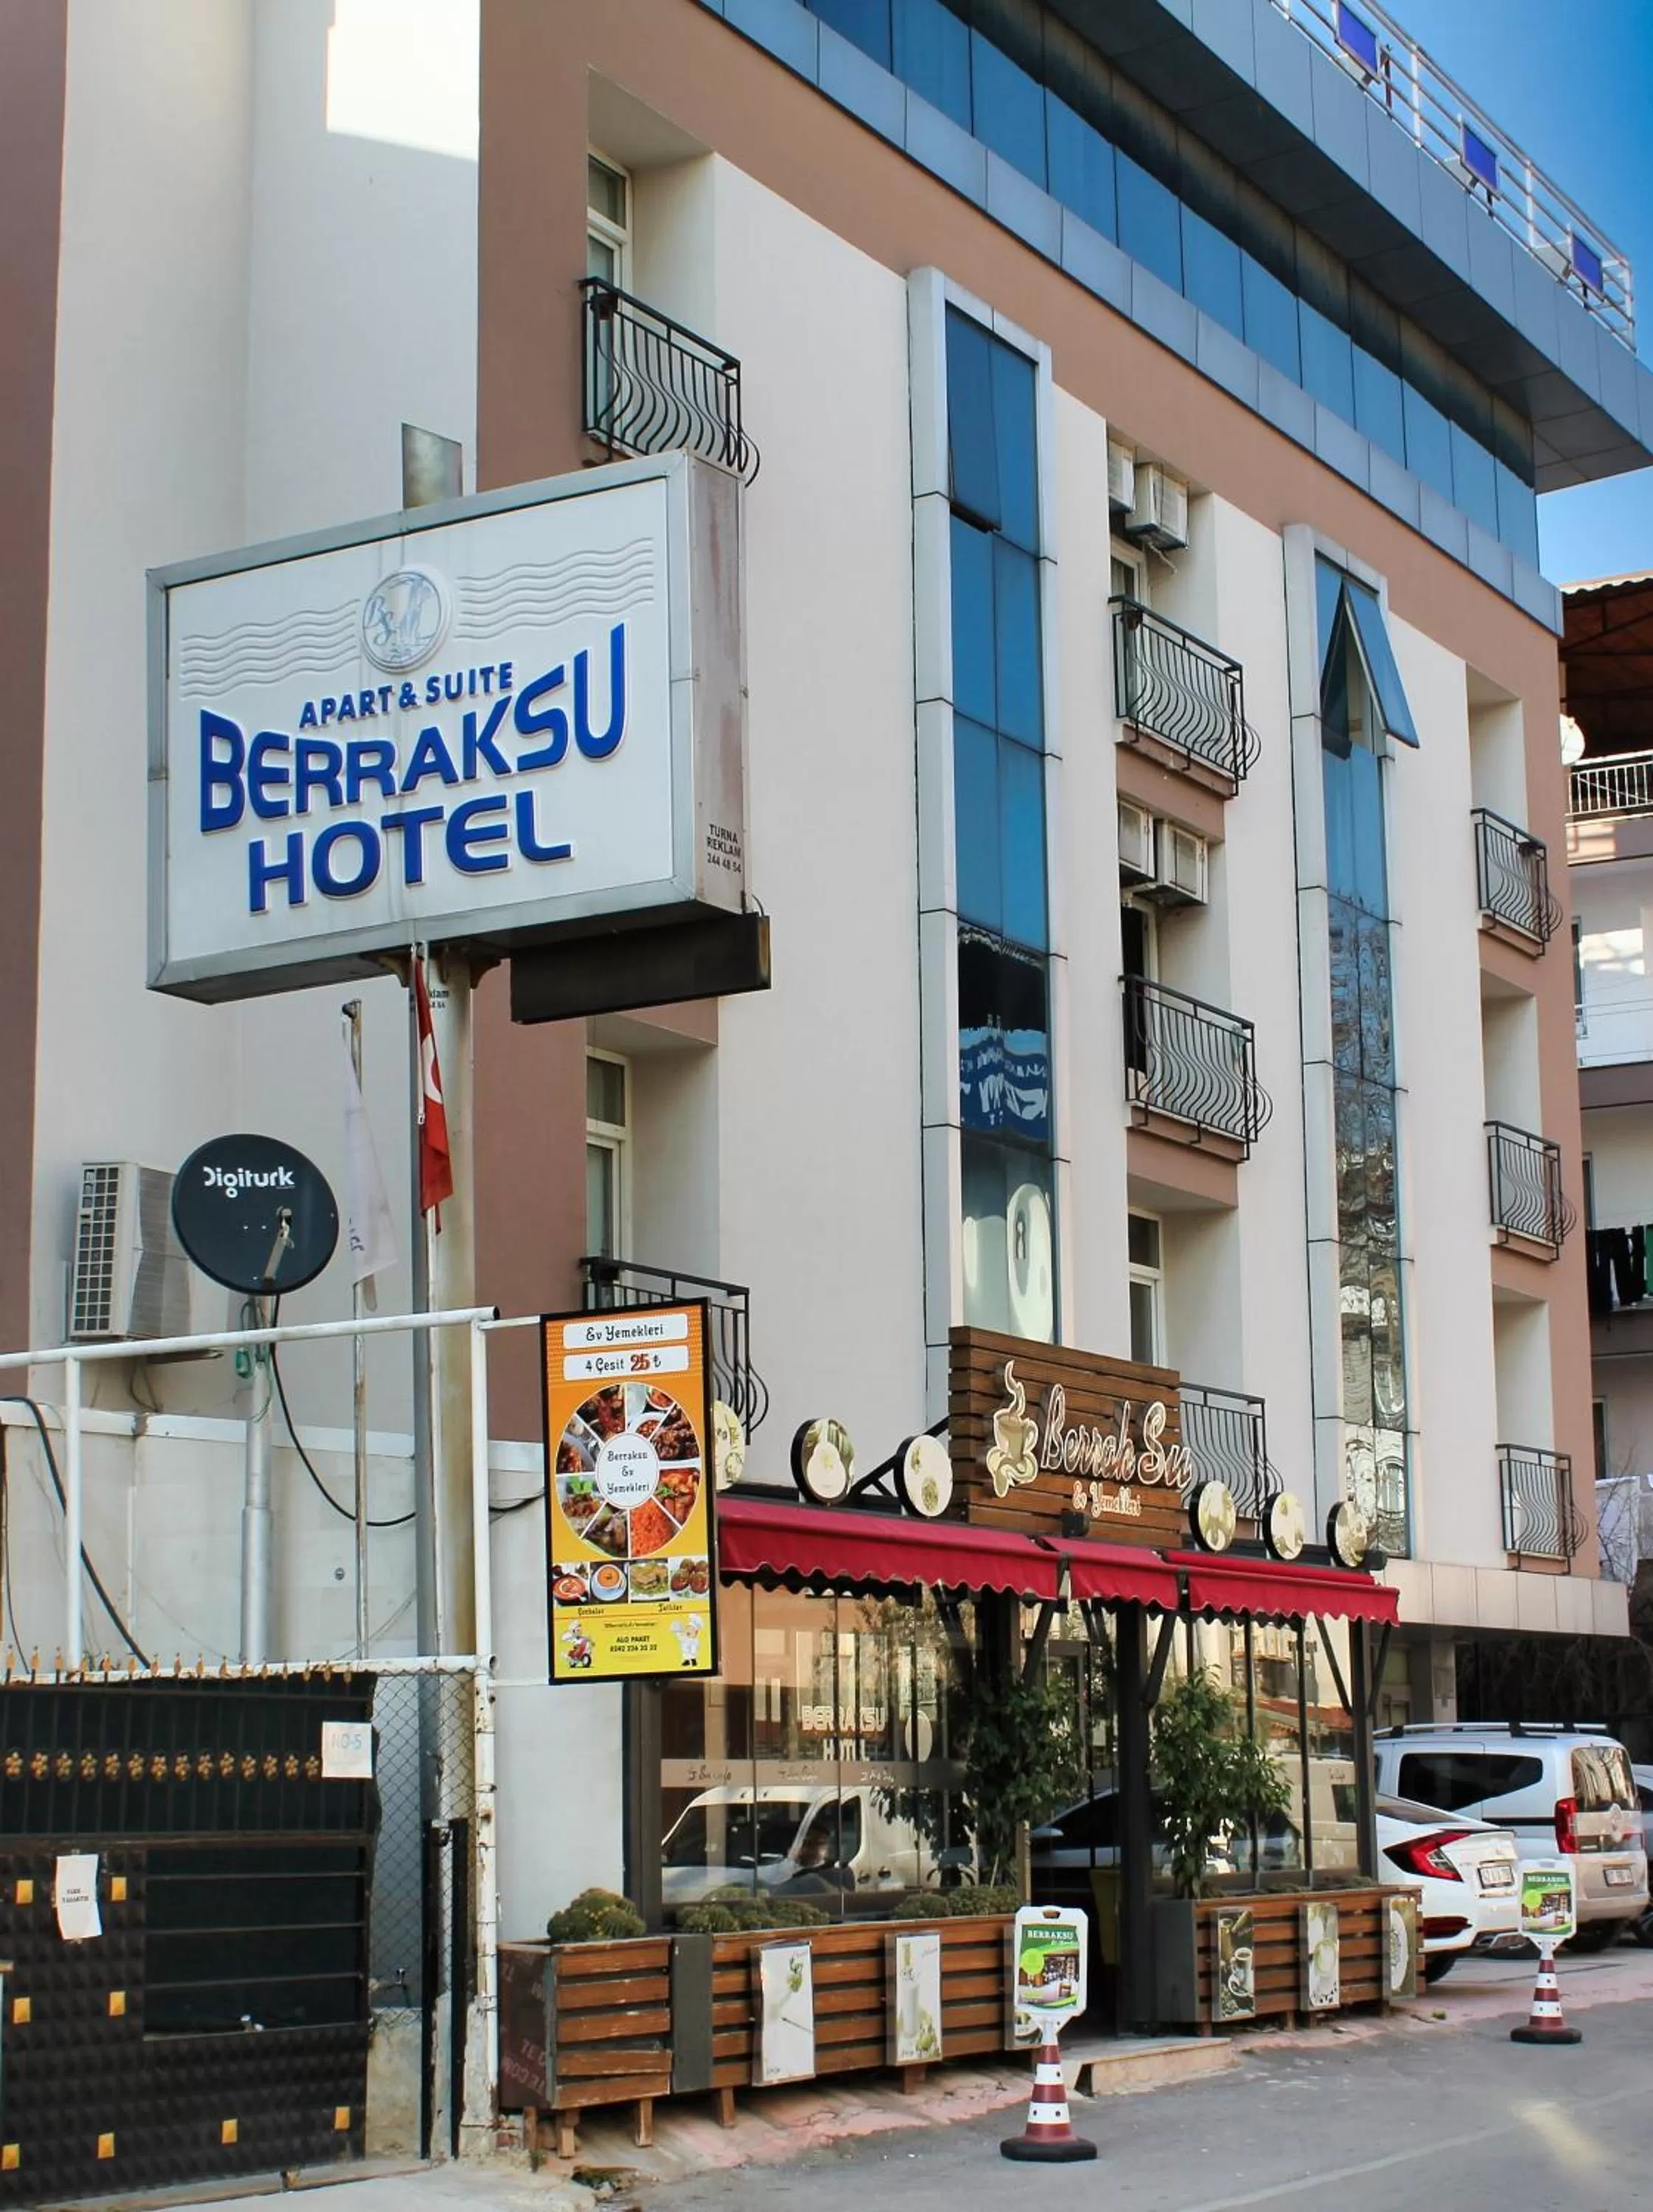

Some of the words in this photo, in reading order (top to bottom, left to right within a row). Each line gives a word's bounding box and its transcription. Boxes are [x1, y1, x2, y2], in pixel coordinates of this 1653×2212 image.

[299, 686, 392, 728] APART
[399, 683, 422, 709] &
[426, 662, 513, 703] SUITE
[201, 622, 625, 832] BERRAKSU
[709, 824, 738, 844] TURNA
[248, 790, 572, 913] HOTEL
[707, 836, 741, 858] REKLAM
[708, 852, 720, 866] 244
[203, 1166, 295, 1198] Digiturk
[606, 1324, 664, 1341] Yemekleri
[585, 1360, 592, 1371] 4
[630, 1353, 650, 1371] 25
[1138, 1401, 1191, 1487] Su
[607, 1450, 648, 1462] Berraksu
[607, 1482, 649, 1495] Yemekleri
[1027, 1930, 1074, 1940] BERRAKSU
